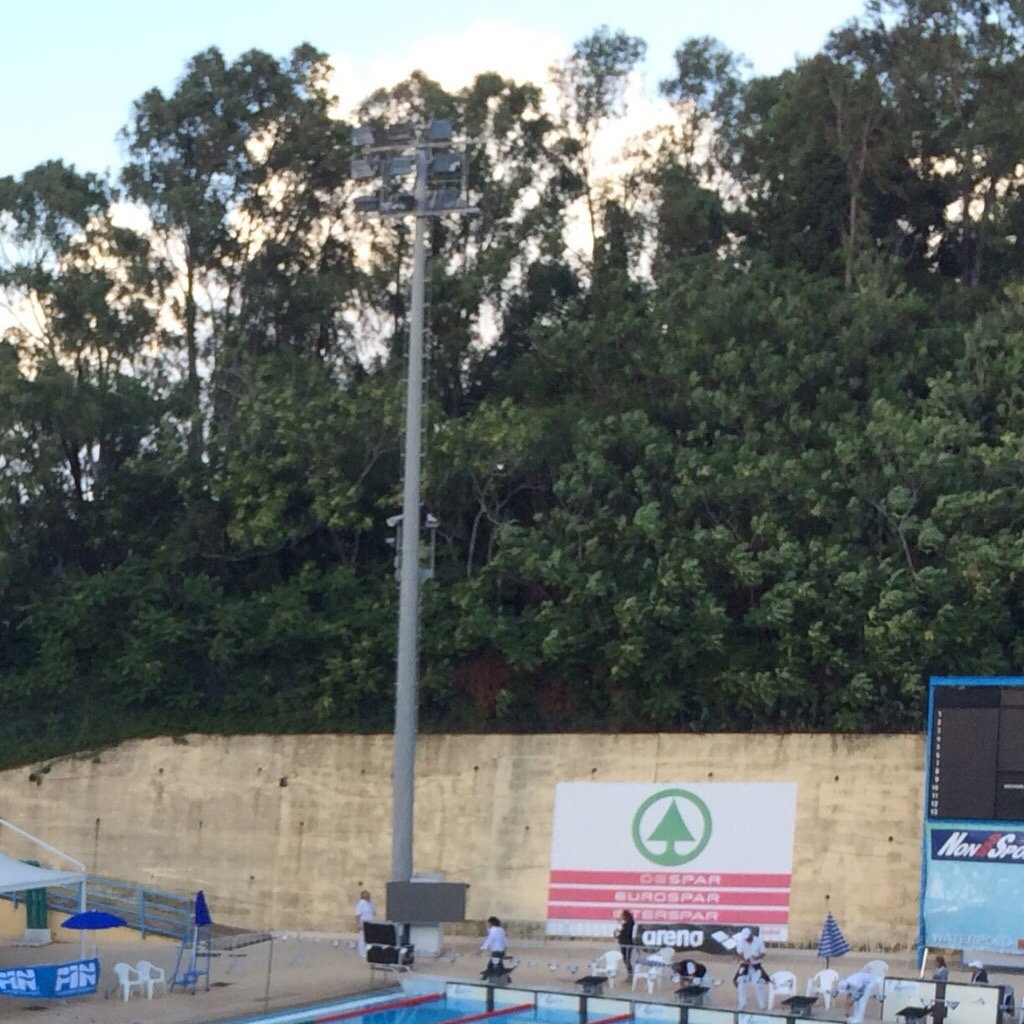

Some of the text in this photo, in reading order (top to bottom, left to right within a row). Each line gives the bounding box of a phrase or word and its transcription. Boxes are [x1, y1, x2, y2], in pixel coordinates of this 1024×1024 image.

[640, 874, 721, 885] DESPAR
[614, 891, 720, 903] EUROSPAR
[642, 930, 704, 947] arena
